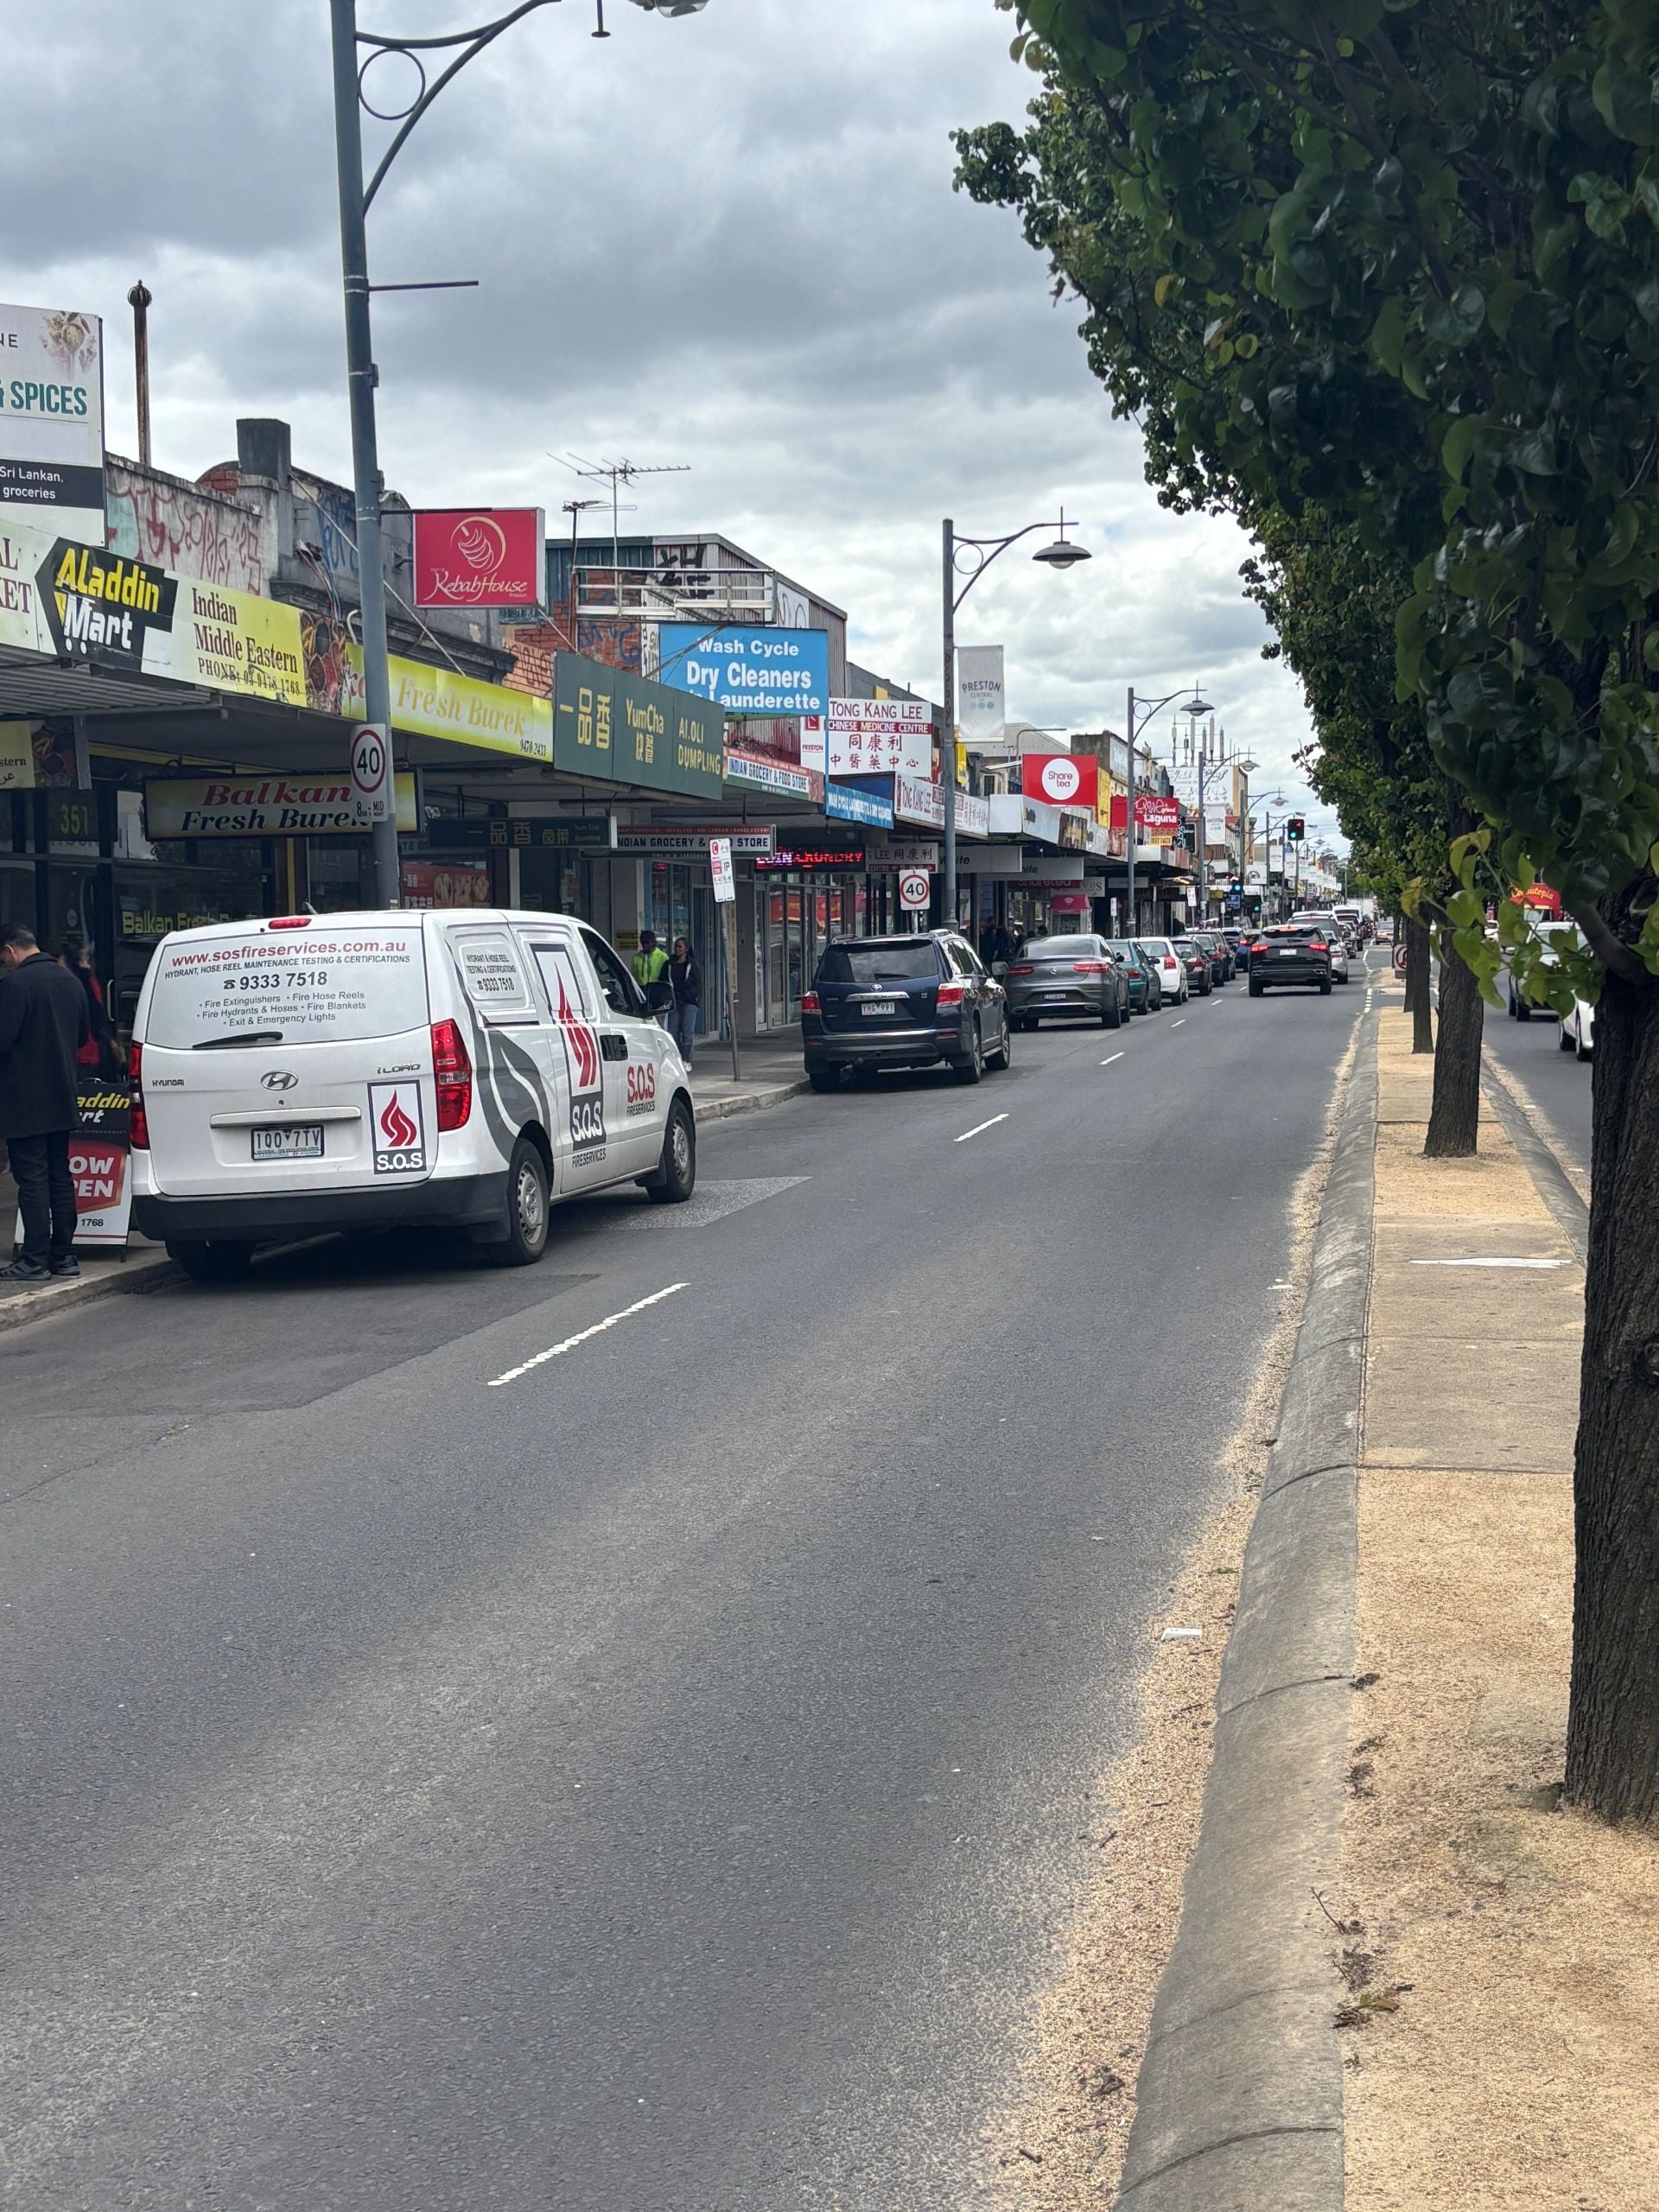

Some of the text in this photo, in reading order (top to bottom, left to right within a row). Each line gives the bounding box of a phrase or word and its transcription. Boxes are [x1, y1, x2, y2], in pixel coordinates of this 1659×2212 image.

[0, 333, 18, 349] E
[10, 380, 87, 416] SPICES
[0, 467, 64, 483] Sri Lankan.
[3, 486, 56, 500] groceries
[54, 548, 160, 613] Aladdin
[0, 577, 32, 613] ET
[192, 588, 238, 625] Indian
[64, 594, 133, 650] Mart
[194, 623, 298, 674] Middle Eastern
[697, 639, 799, 658] Wash Cycle
[686, 660, 812, 690] Dry Cleaners
[281, 679, 300, 695] 1768
[962, 680, 1001, 694] PRESTON
[397, 677, 462, 723] Fresh
[467, 697, 526, 737] Burek
[709, 690, 821, 709] Launderette
[560, 687, 611, 750] 一品香
[830, 701, 923, 720] TONG KANG LEE
[828, 721, 928, 734] CHINESE MEDICINE CENTRE
[849, 734, 903, 752] 同康利
[357, 747, 380, 775] 40
[677, 744, 721, 775] DUMPLING
[748, 764, 772, 782] GROCERY
[792, 775, 807, 790] STORE
[1048, 771, 1072, 780] Share
[1057, 779, 1071, 788] tea
[201, 782, 353, 806] Balkan
[60, 804, 88, 836] 351
[181, 809, 265, 832] Fresh
[1143, 815, 1177, 825] Laguna
[467, 821, 532, 845] 一品香
[618, 837, 646, 848] NDIAN
[650, 837, 695, 848] GROCERY
[698, 837, 705, 847] &
[737, 837, 768, 847] STORE
[874, 849, 890, 859] LEE
[906, 883, 925, 895] 40
[122, 909, 173, 934] Balkan
[172, 940, 406, 966] www.sosfireservices.com.au
[165, 967, 200, 979] HYDRANT,
[200, 964, 220, 974] HOSE
[223, 963, 242, 972] REEL
[244, 958, 299, 969] MAINTENANCE
[302, 957, 334, 965] TESTING
[344, 954, 410, 964] CERTIFICATIONS
[239, 971, 327, 990] 9333 7518
[482, 977, 515, 991] 9333 7518
[205, 990, 365, 1008] Fire Extinguishers Fire Hose Reels
[202, 1000, 366, 1020] Fire Hydrants & Hoses Fire Blankets
[229, 1012, 336, 1027] Exit & Emergency Lights
[627, 1063, 655, 1103] S.O.S
[76, 1092, 130, 1109] addin
[79, 1109, 105, 1123] rt
[572, 1101, 603, 1141] S.O.S
[69, 1156, 114, 1174] OW
[377, 1152, 423, 1170] S.O.S
[73, 1179, 113, 1198] EN
[81, 1218, 104, 1227] 1768
